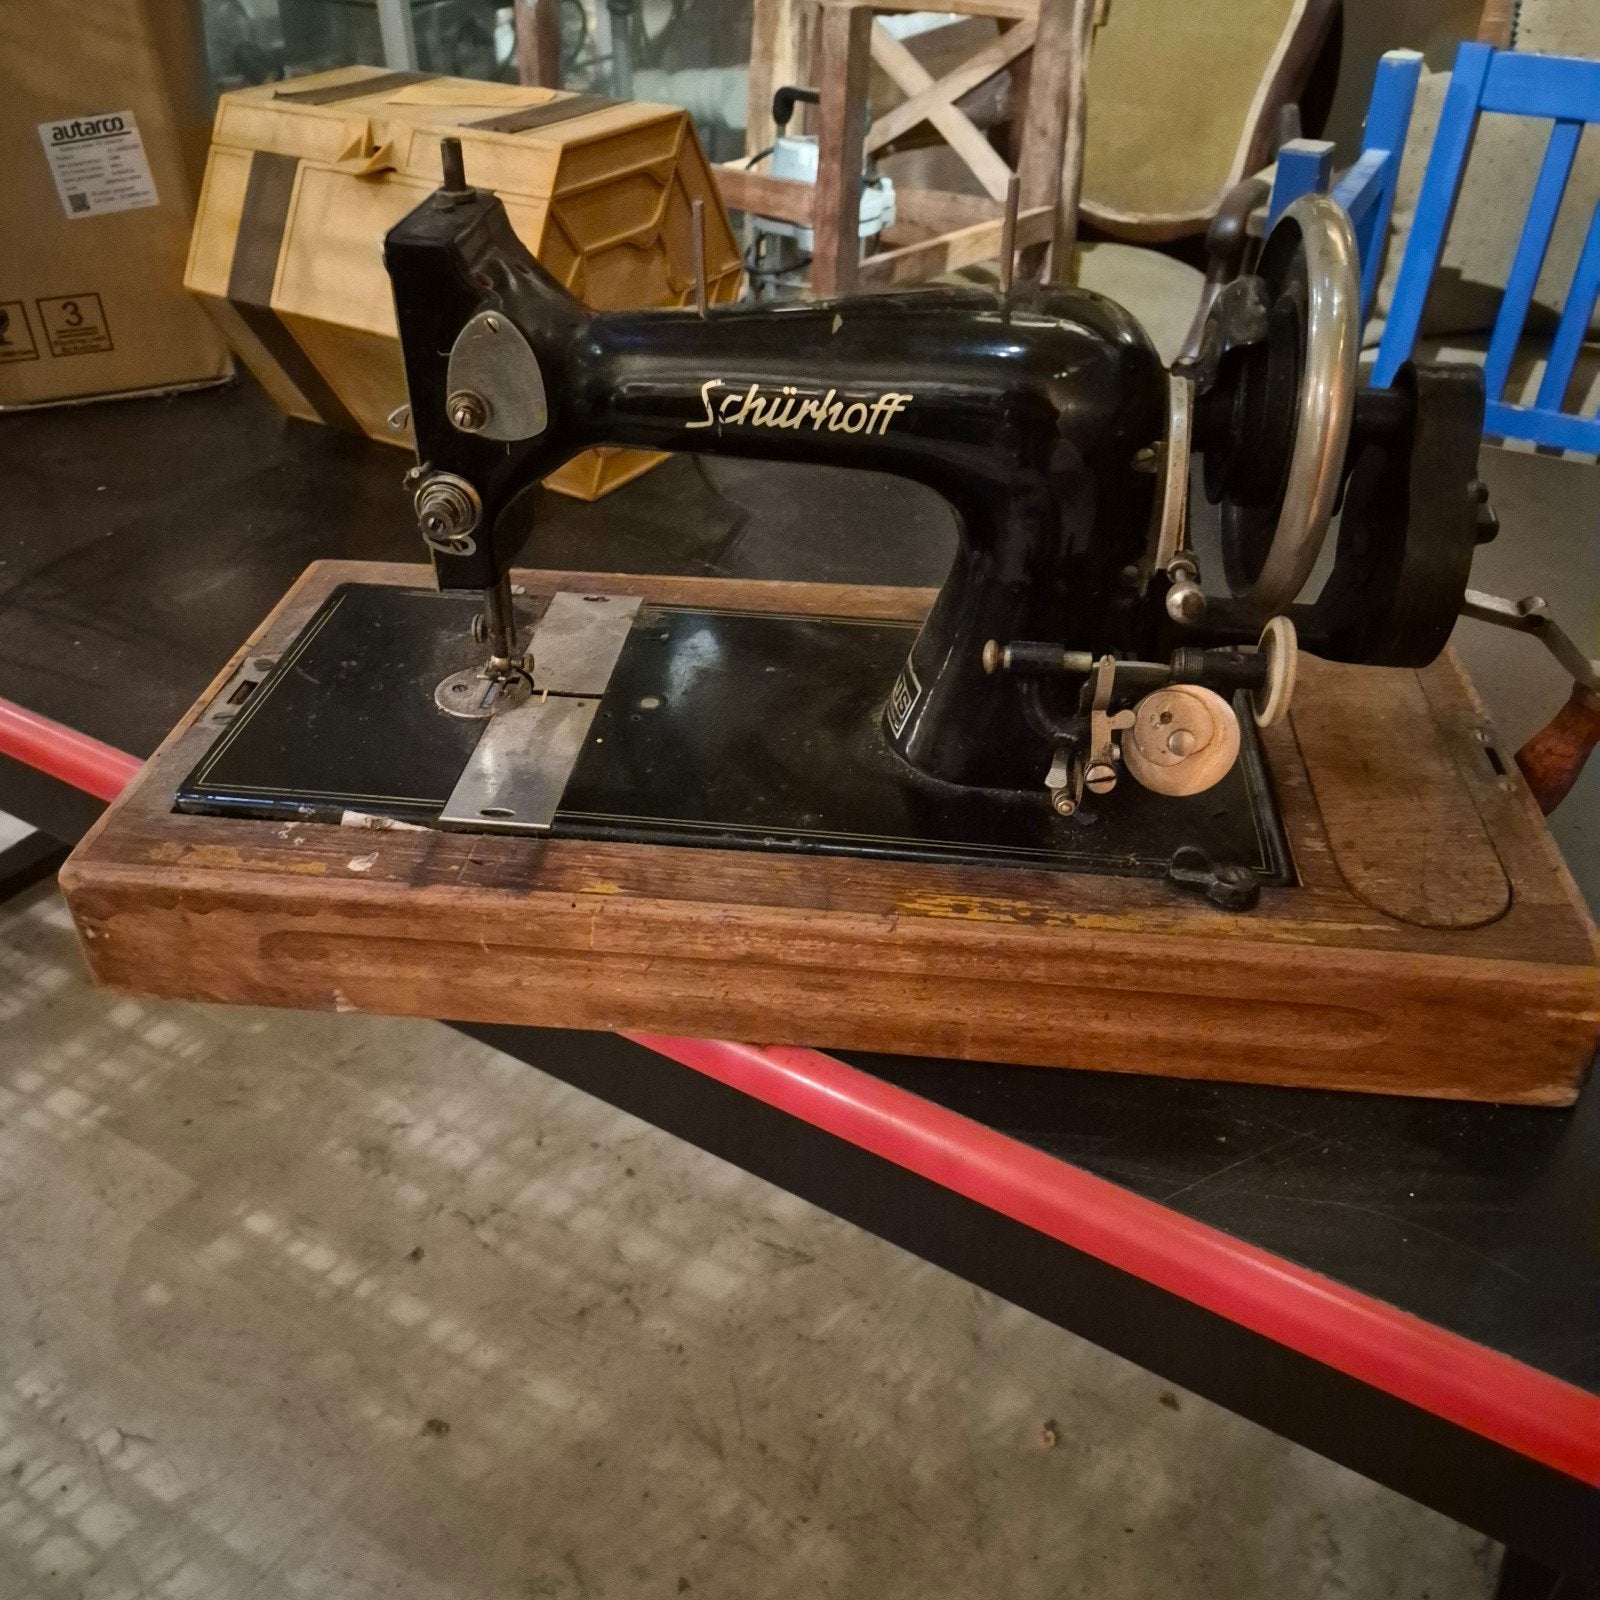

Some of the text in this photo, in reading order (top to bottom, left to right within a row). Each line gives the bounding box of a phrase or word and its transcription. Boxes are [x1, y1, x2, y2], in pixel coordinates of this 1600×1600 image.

[52, 116, 125, 141] autarco
[62, 301, 84, 326] 3
[685, 378, 914, 436] Schürhoff
